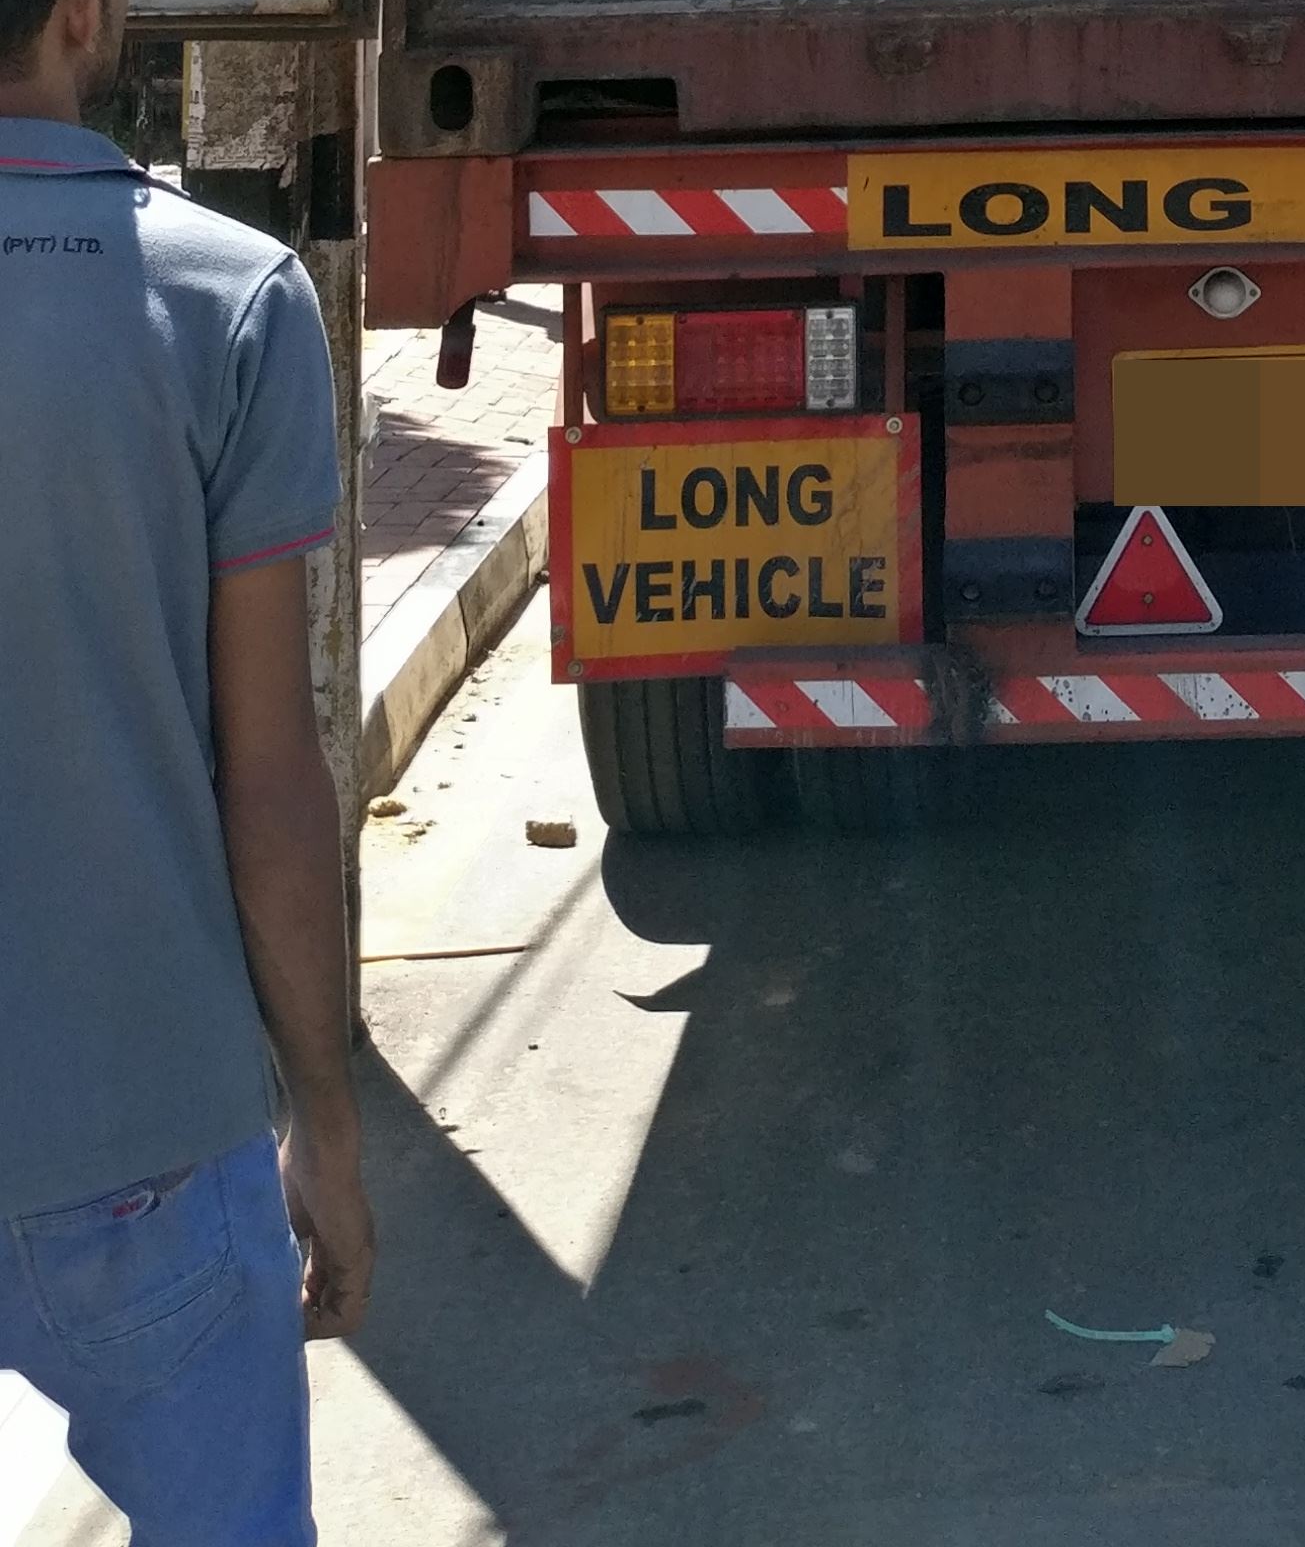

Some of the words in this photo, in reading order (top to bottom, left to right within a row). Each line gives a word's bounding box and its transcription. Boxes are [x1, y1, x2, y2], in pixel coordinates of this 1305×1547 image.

[882, 177, 1252, 237] LONG
[3, 235, 56, 256] (PVT)
[63, 236, 104, 254] LTD.
[640, 463, 832, 531] LONG
[582, 555, 886, 624] VEHICLE
